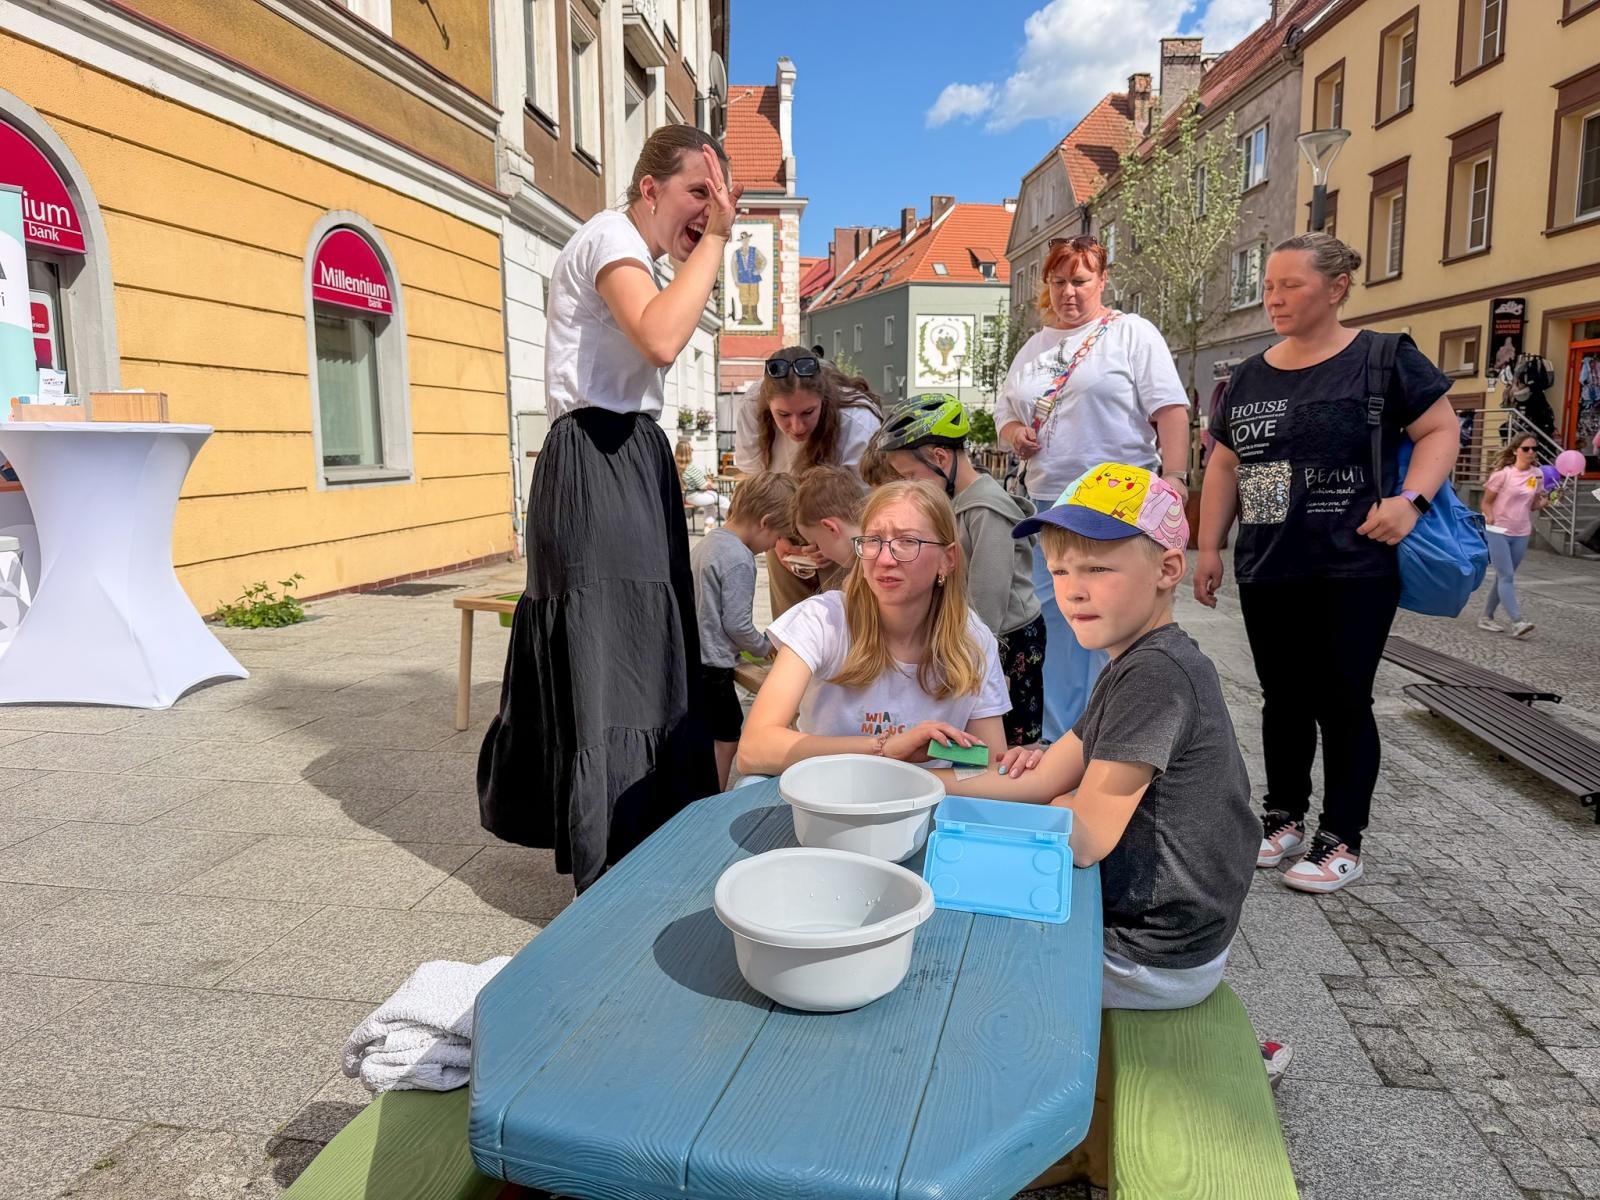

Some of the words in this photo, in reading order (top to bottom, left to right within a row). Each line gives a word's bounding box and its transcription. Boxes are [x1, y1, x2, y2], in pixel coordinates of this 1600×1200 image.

[28, 221, 60, 241] bank
[320, 260, 387, 299] Millennium
[1231, 399, 1288, 420] HOUSE
[1232, 420, 1277, 446] LOVE
